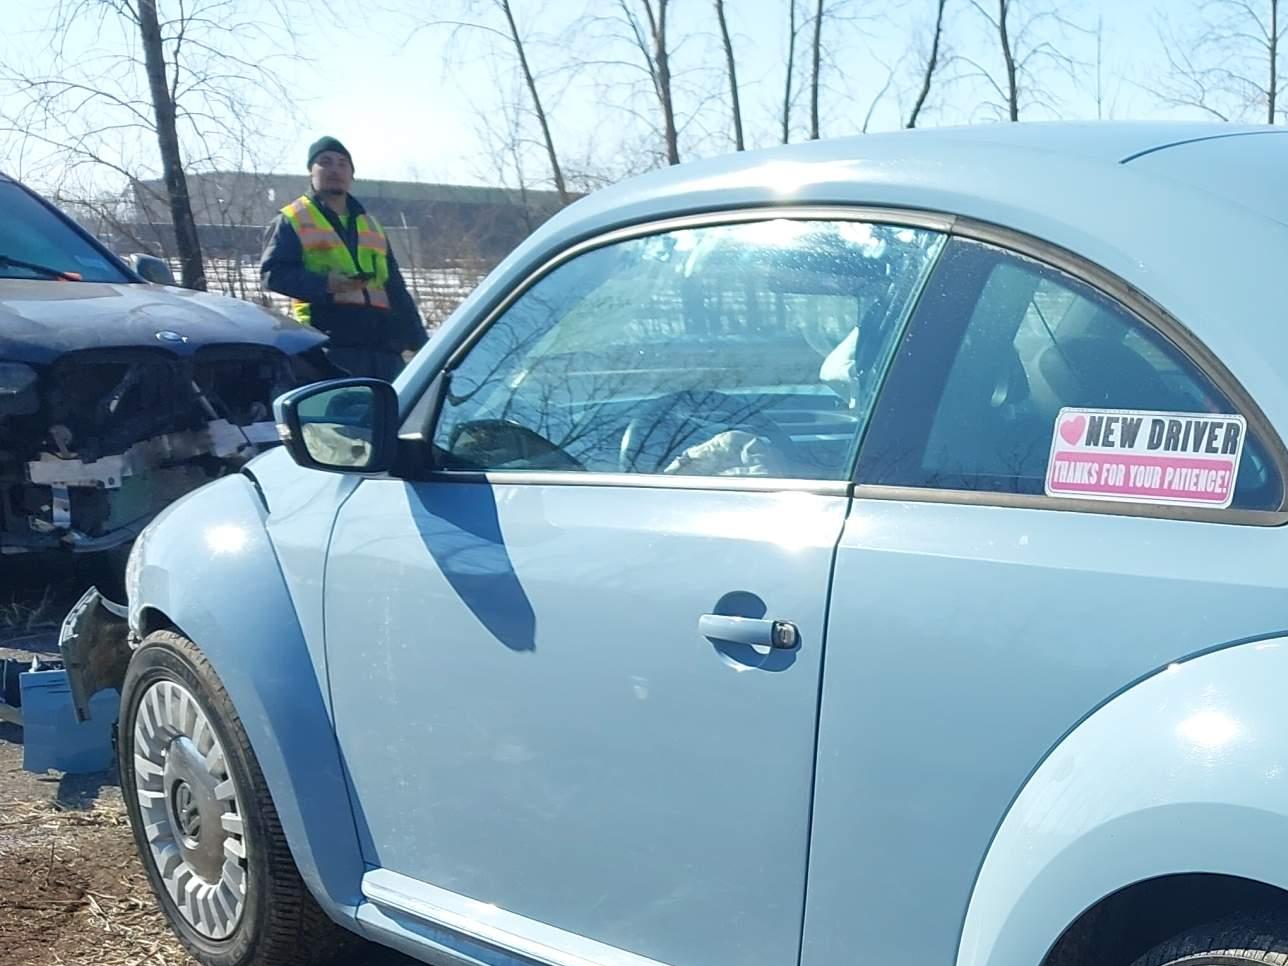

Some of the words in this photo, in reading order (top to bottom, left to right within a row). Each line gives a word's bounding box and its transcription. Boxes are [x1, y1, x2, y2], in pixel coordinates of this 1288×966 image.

[1085, 415, 1143, 449] NEW
[1146, 419, 1241, 455] DRIVER
[1053, 461, 1099, 485] THANKS
[1100, 463, 1126, 487] FOR
[1128, 465, 1163, 489] YOUR
